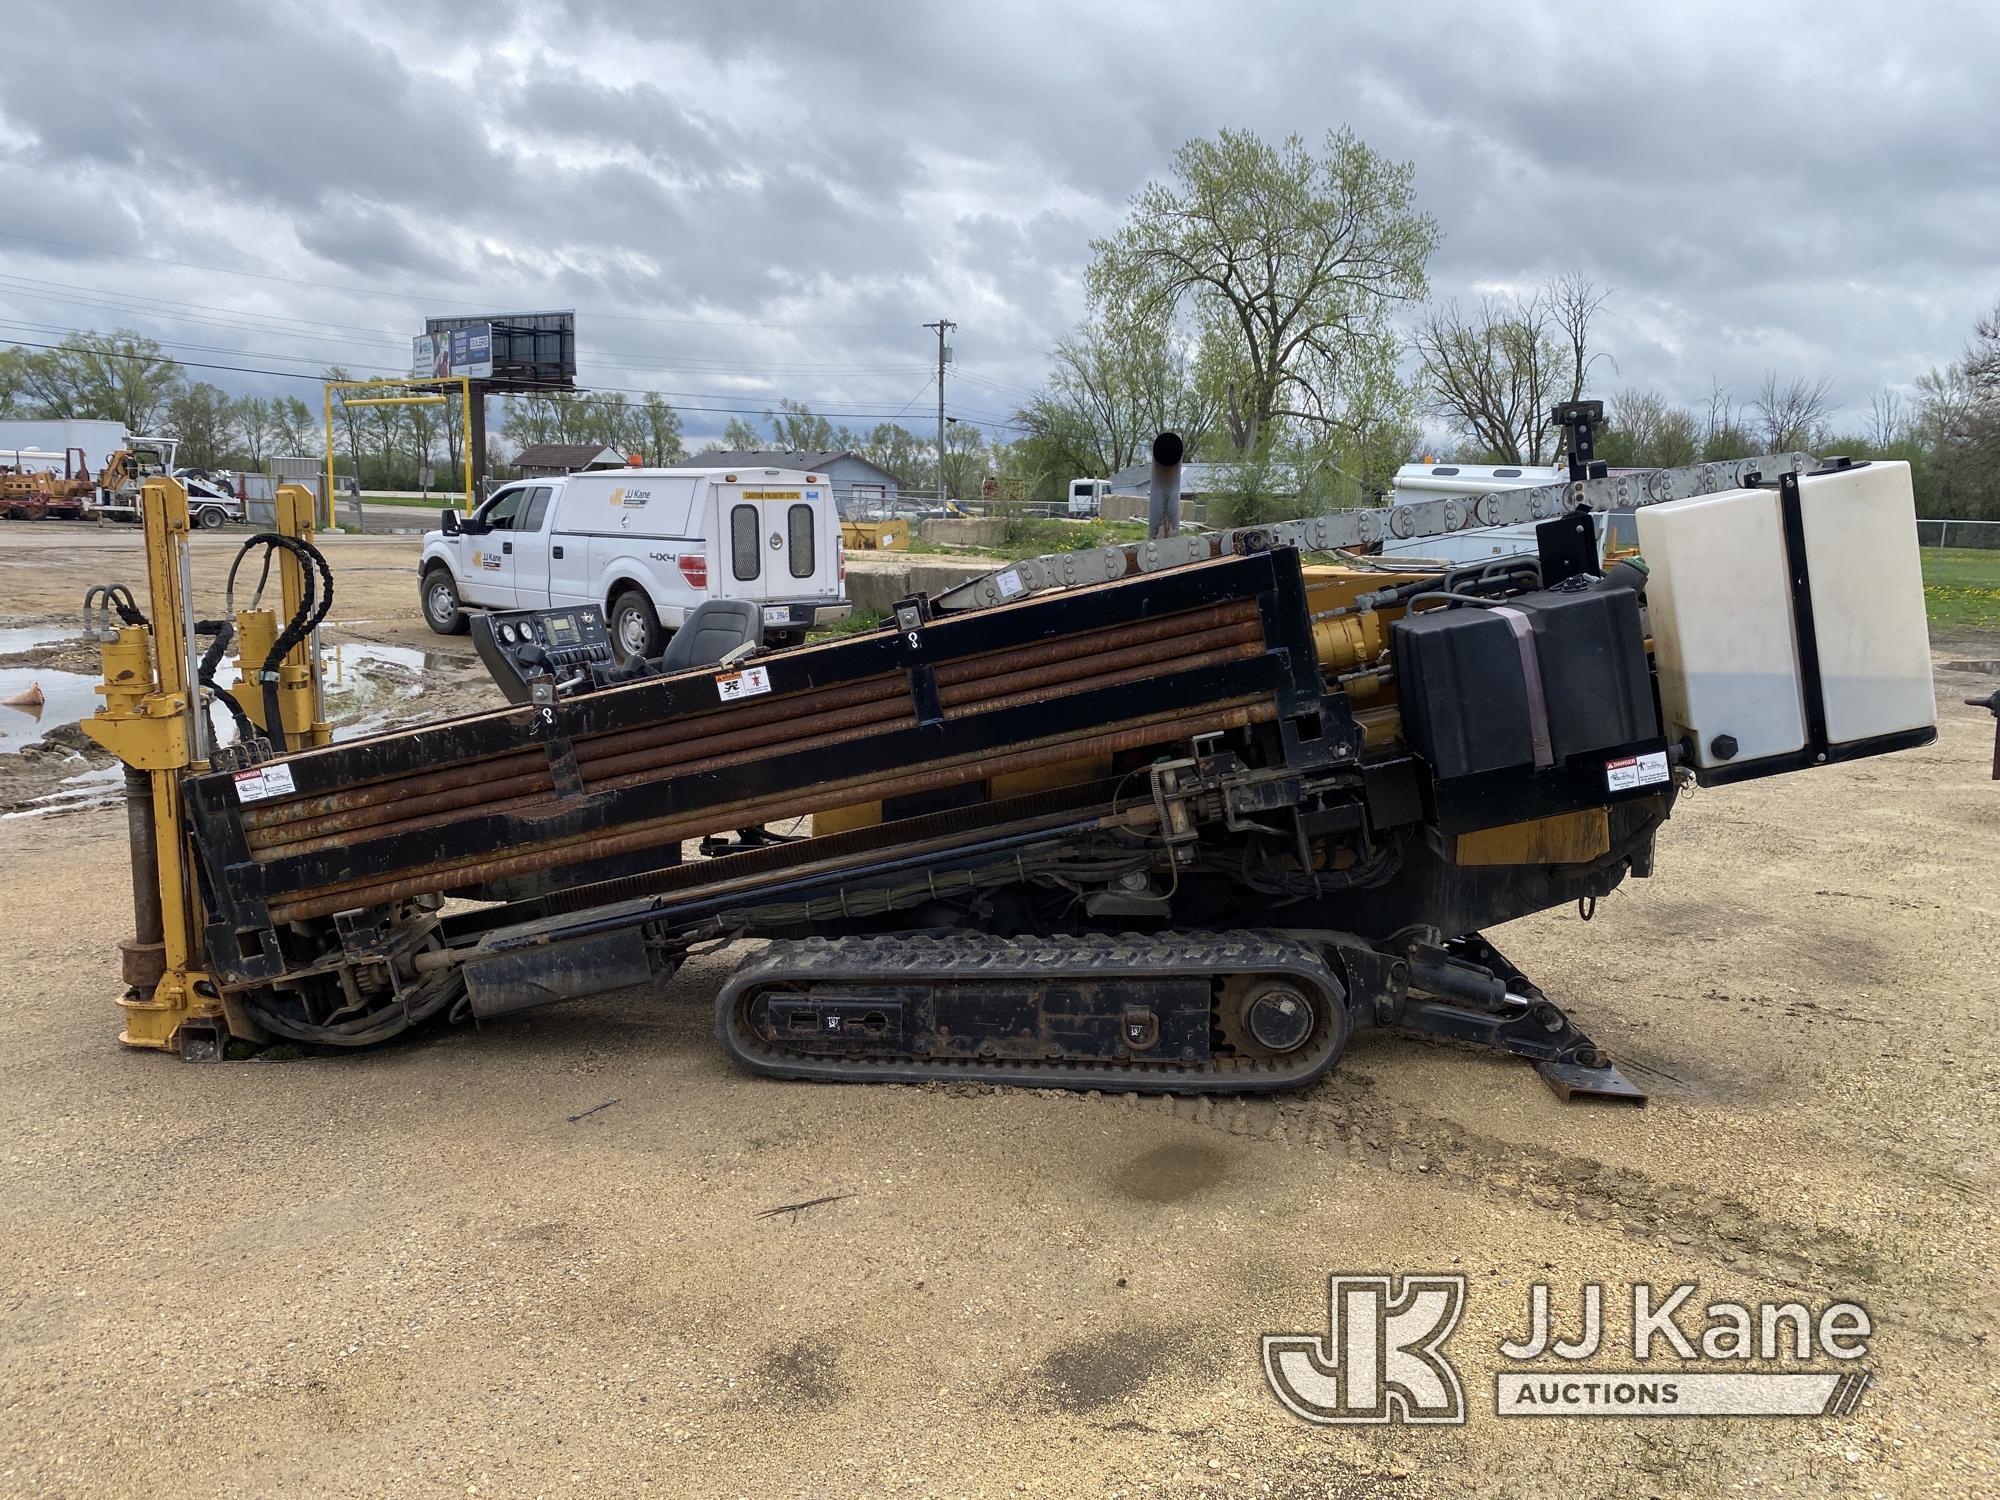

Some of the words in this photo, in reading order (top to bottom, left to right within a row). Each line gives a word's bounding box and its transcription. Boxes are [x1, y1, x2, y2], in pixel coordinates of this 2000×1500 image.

[625, 489, 634, 498] JJ
[634, 489, 651, 498] Kane
[488, 552, 502, 562] Kane
[1613, 758, 1636, 767] DANGER
[240, 770, 261, 779] DANGER
